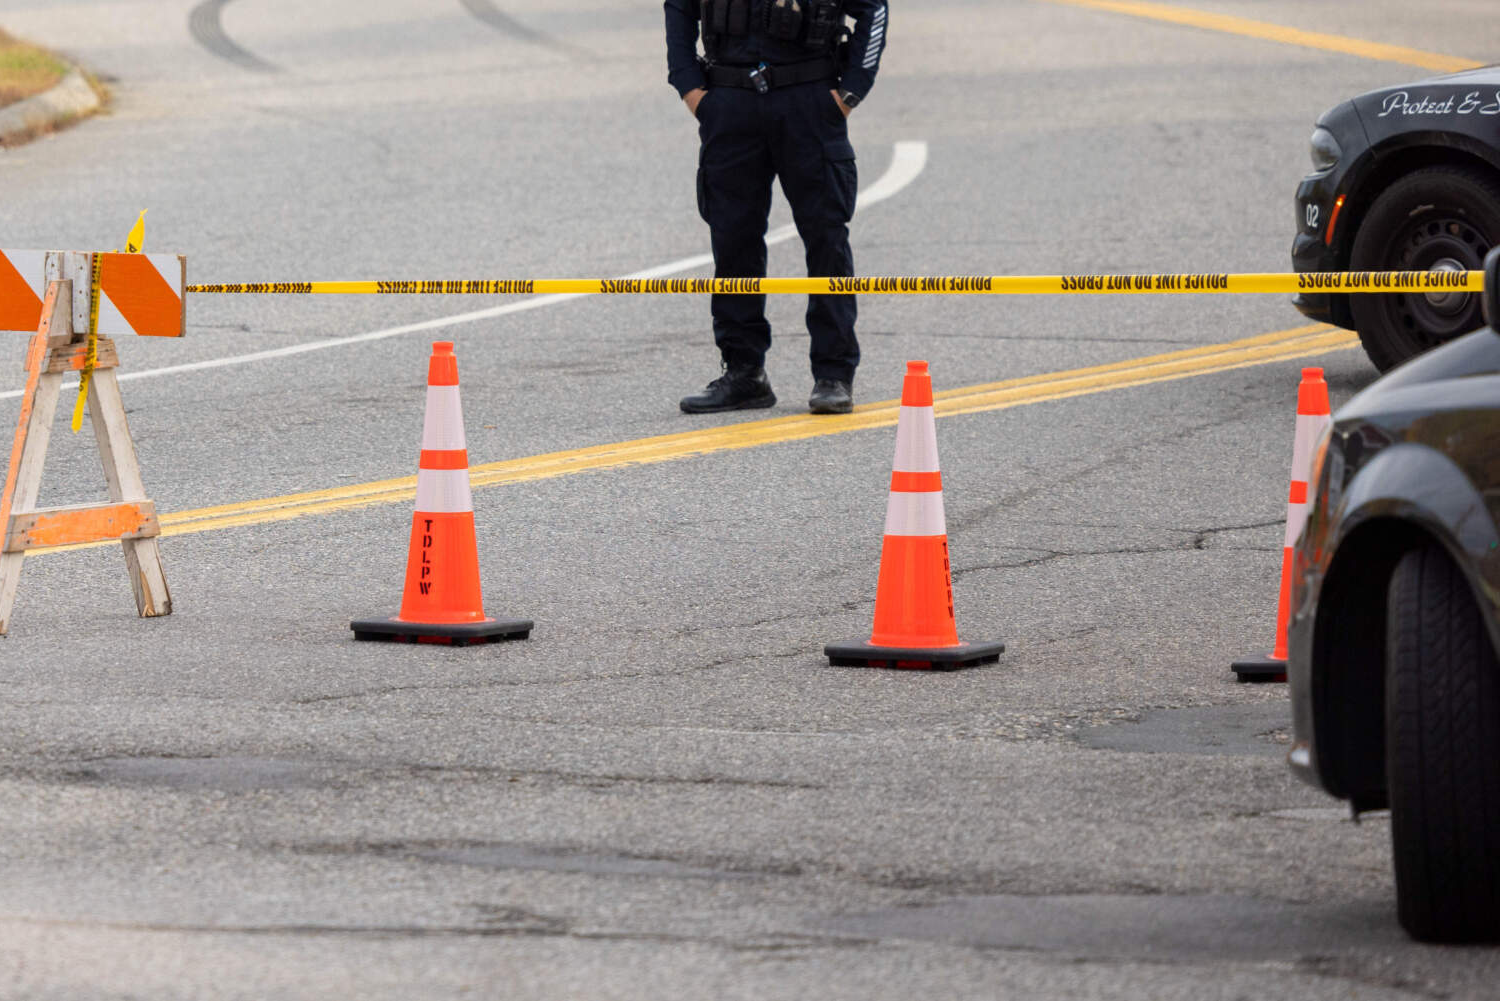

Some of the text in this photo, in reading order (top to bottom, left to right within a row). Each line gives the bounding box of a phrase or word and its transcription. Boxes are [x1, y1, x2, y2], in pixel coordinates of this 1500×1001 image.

[1378, 91, 1455, 116] Protect
[1457, 91, 1481, 114] &
[1306, 203, 1319, 228] 02
[419, 519, 433, 595] TDLPW
